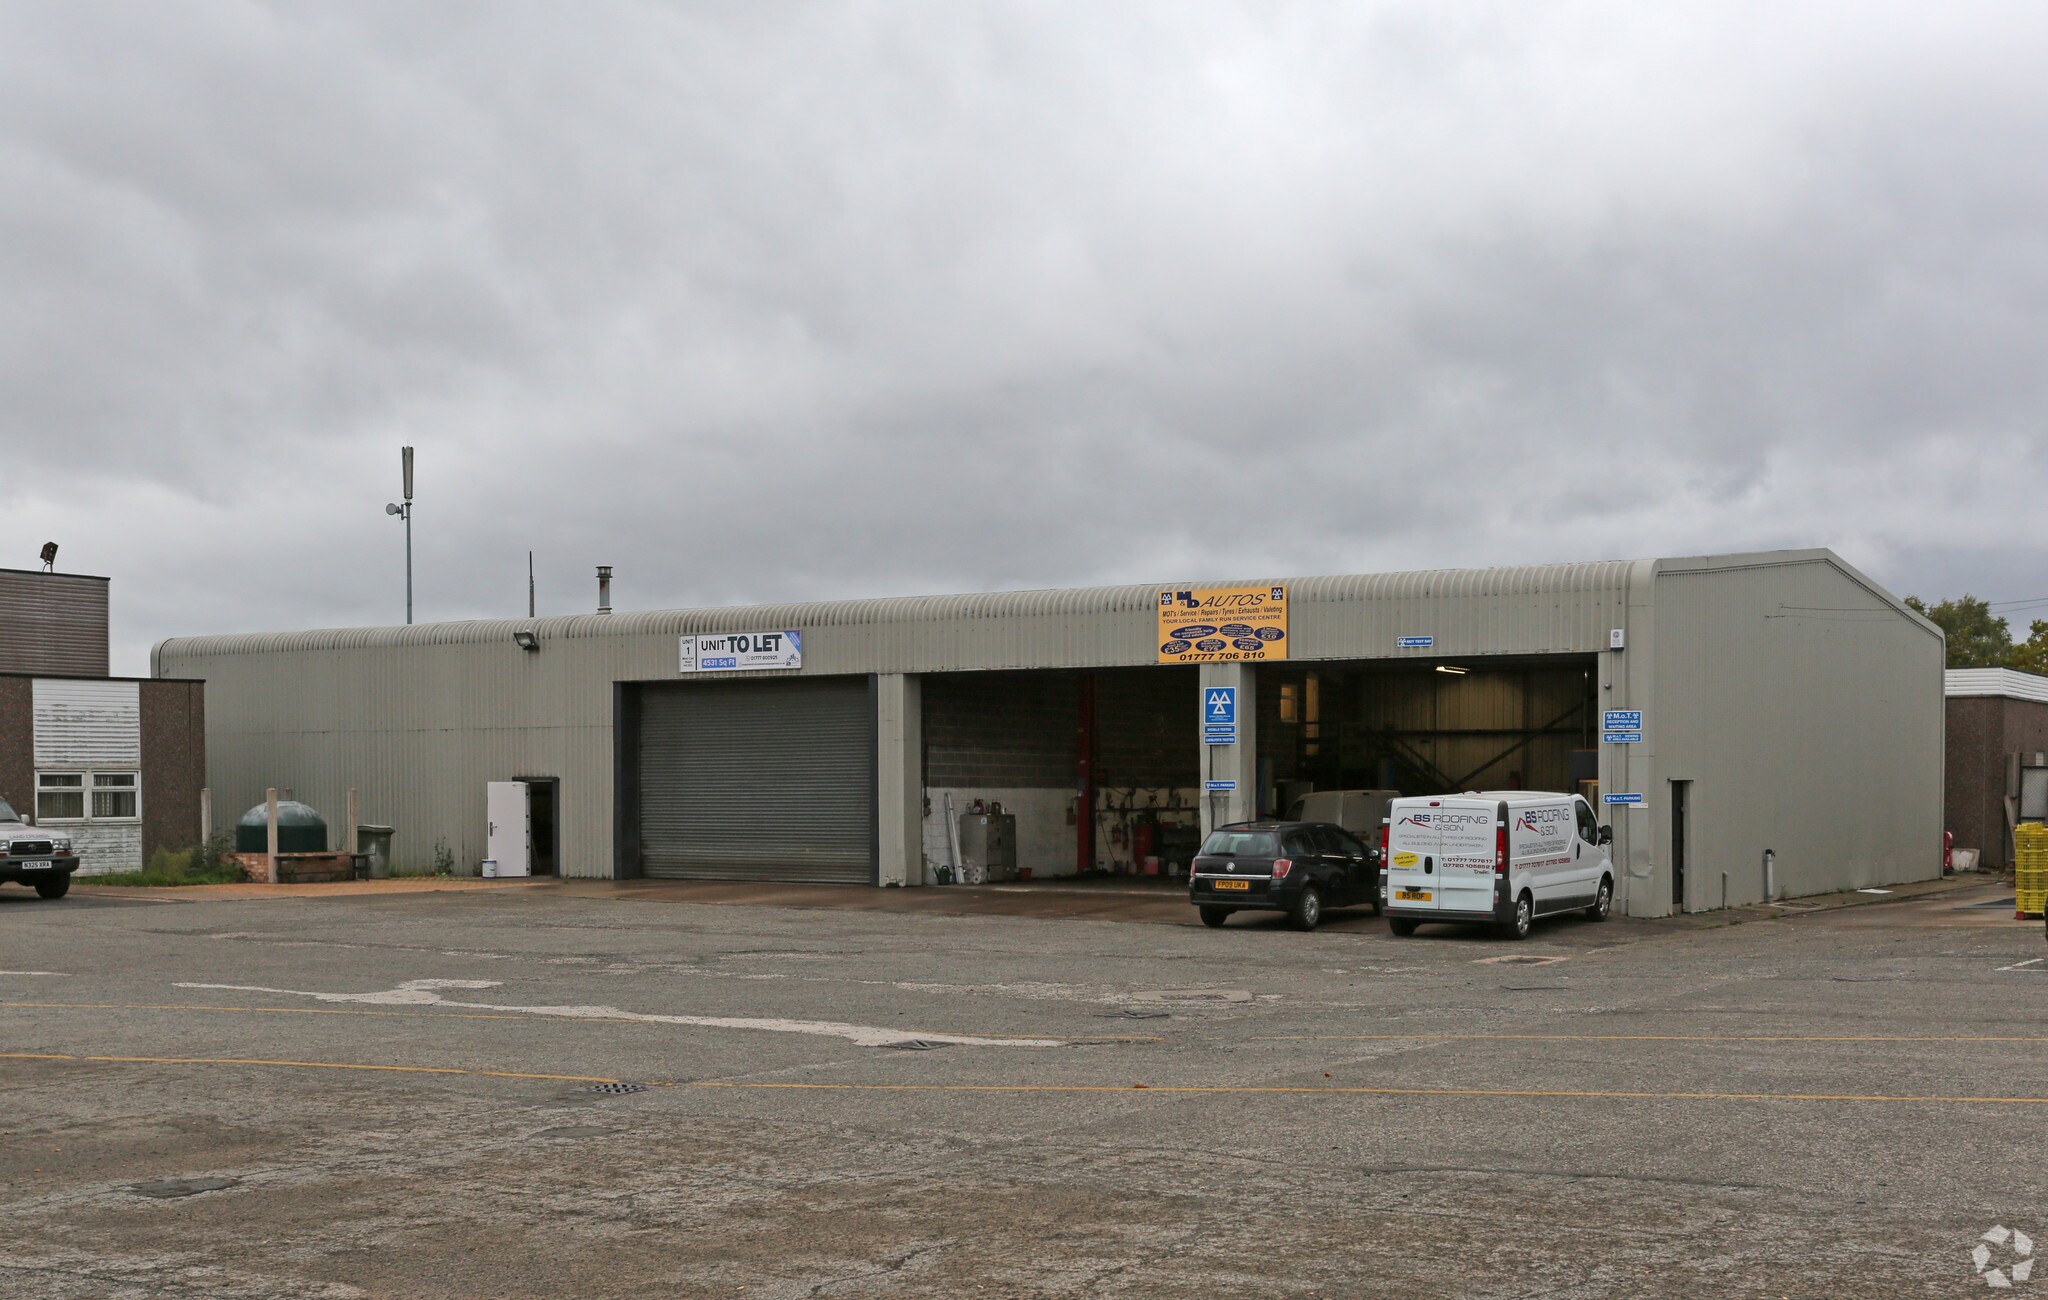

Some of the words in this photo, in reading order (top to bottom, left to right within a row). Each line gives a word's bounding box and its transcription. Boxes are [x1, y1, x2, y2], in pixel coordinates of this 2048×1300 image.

[1200, 594, 1266, 608] AUTOS
[1222, 608, 1234, 616] Tyres
[701, 640, 726, 651] UNIT
[727, 636, 749, 653] TO
[753, 634, 782, 652] LET
[719, 658, 727, 666] Sq
[1433, 815, 1488, 824] ROOFING
[1525, 811, 1537, 823] BS
[1537, 808, 1569, 823] ROOFING
[1546, 825, 1558, 835] SON
